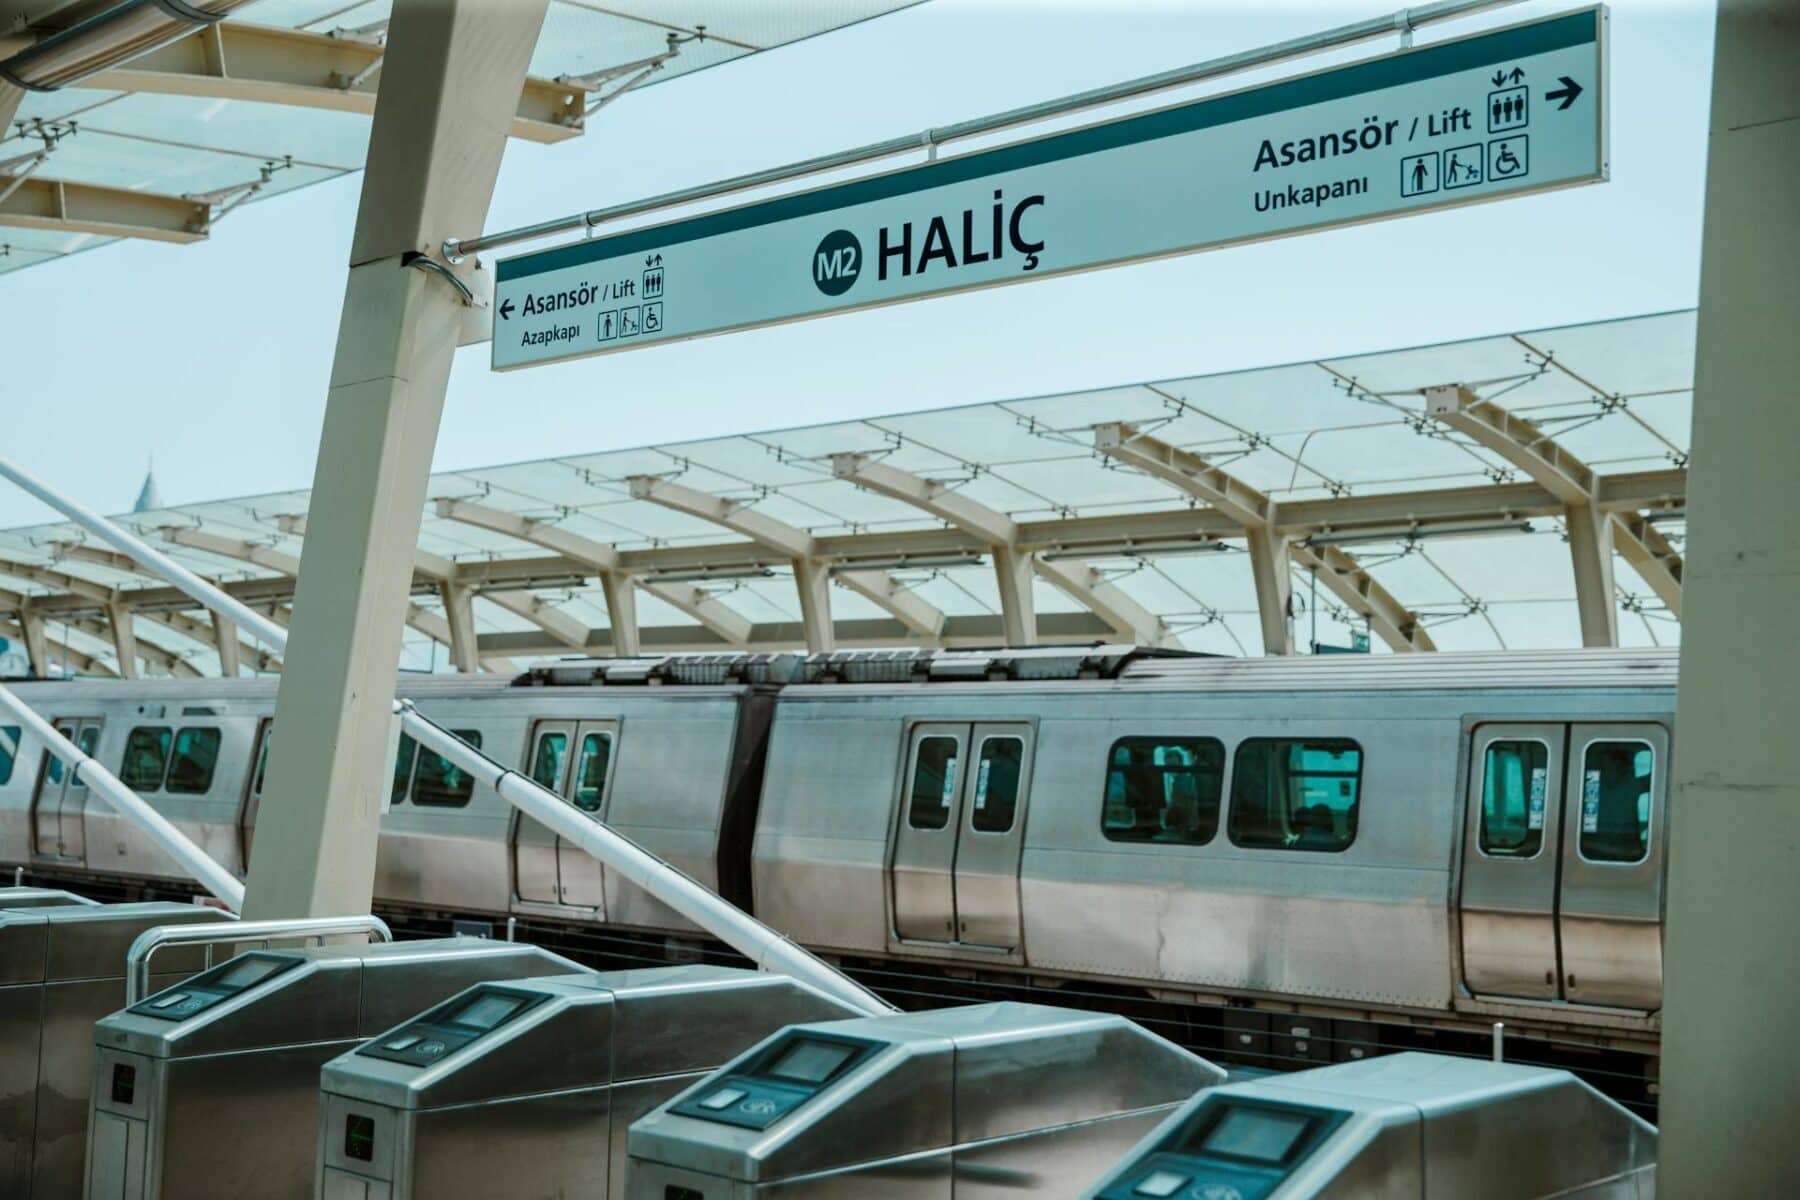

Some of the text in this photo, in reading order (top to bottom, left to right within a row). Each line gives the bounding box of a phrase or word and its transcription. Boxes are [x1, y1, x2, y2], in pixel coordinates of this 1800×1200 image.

[1253, 115, 1399, 172] Asansör
[1428, 107, 1472, 138] Lift
[1254, 176, 1369, 213] Unkapanı
[817, 188, 1045, 282] M2 HALİÇ
[522, 281, 599, 317] Asansör
[612, 279, 636, 300] Lift
[521, 324, 580, 347] Azapkapı
